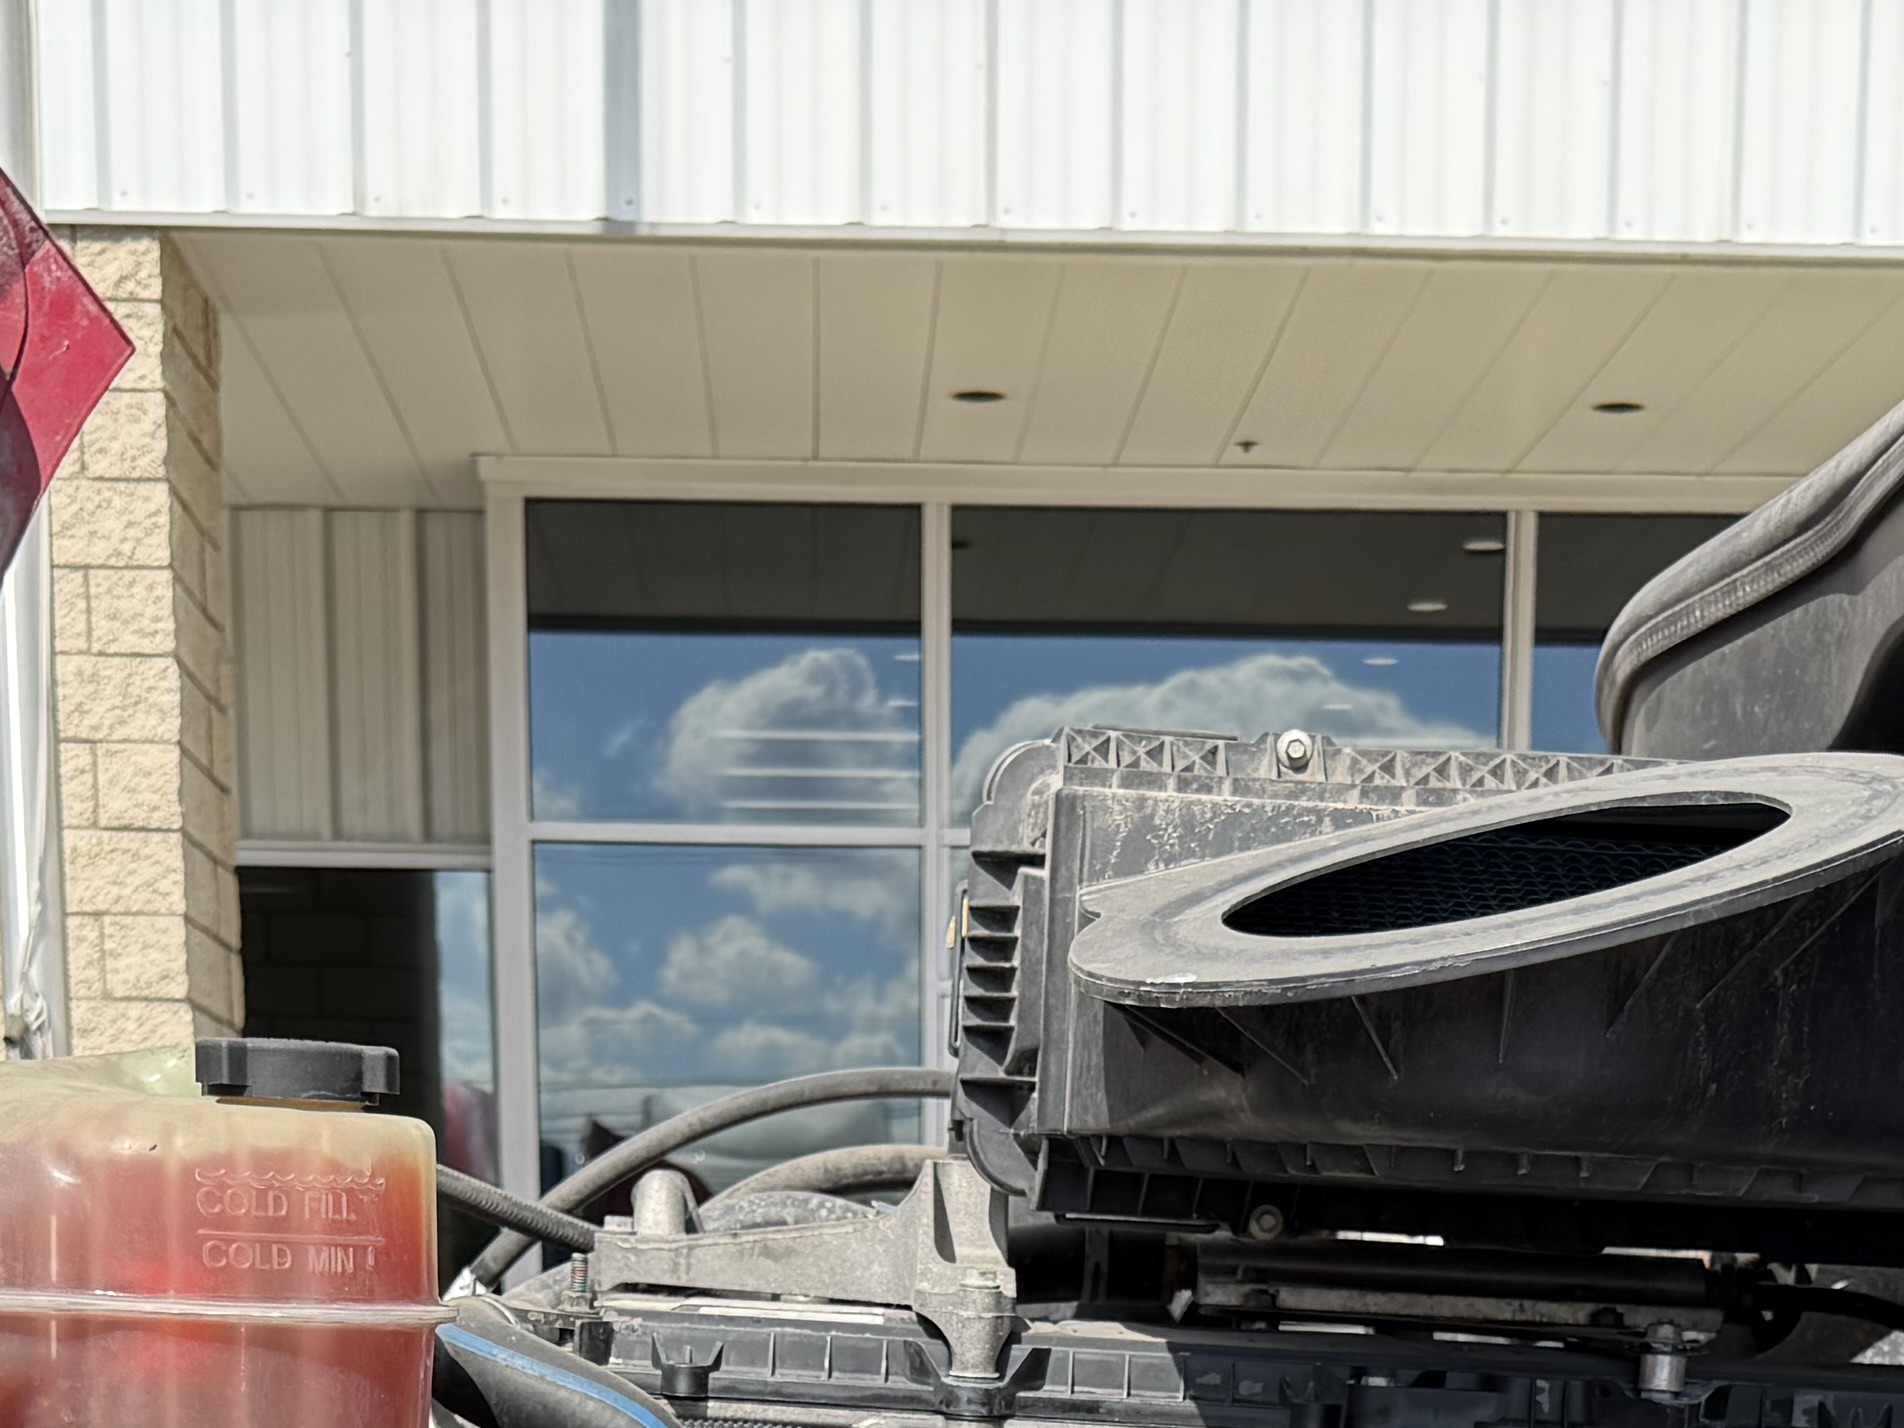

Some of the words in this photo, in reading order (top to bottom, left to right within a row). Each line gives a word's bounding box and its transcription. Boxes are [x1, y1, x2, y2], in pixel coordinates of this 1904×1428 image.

[197, 1187, 288, 1217] COLD
[304, 1190, 356, 1220] FILL
[202, 1240, 292, 1269] COLD
[307, 1246, 354, 1274] MIN
